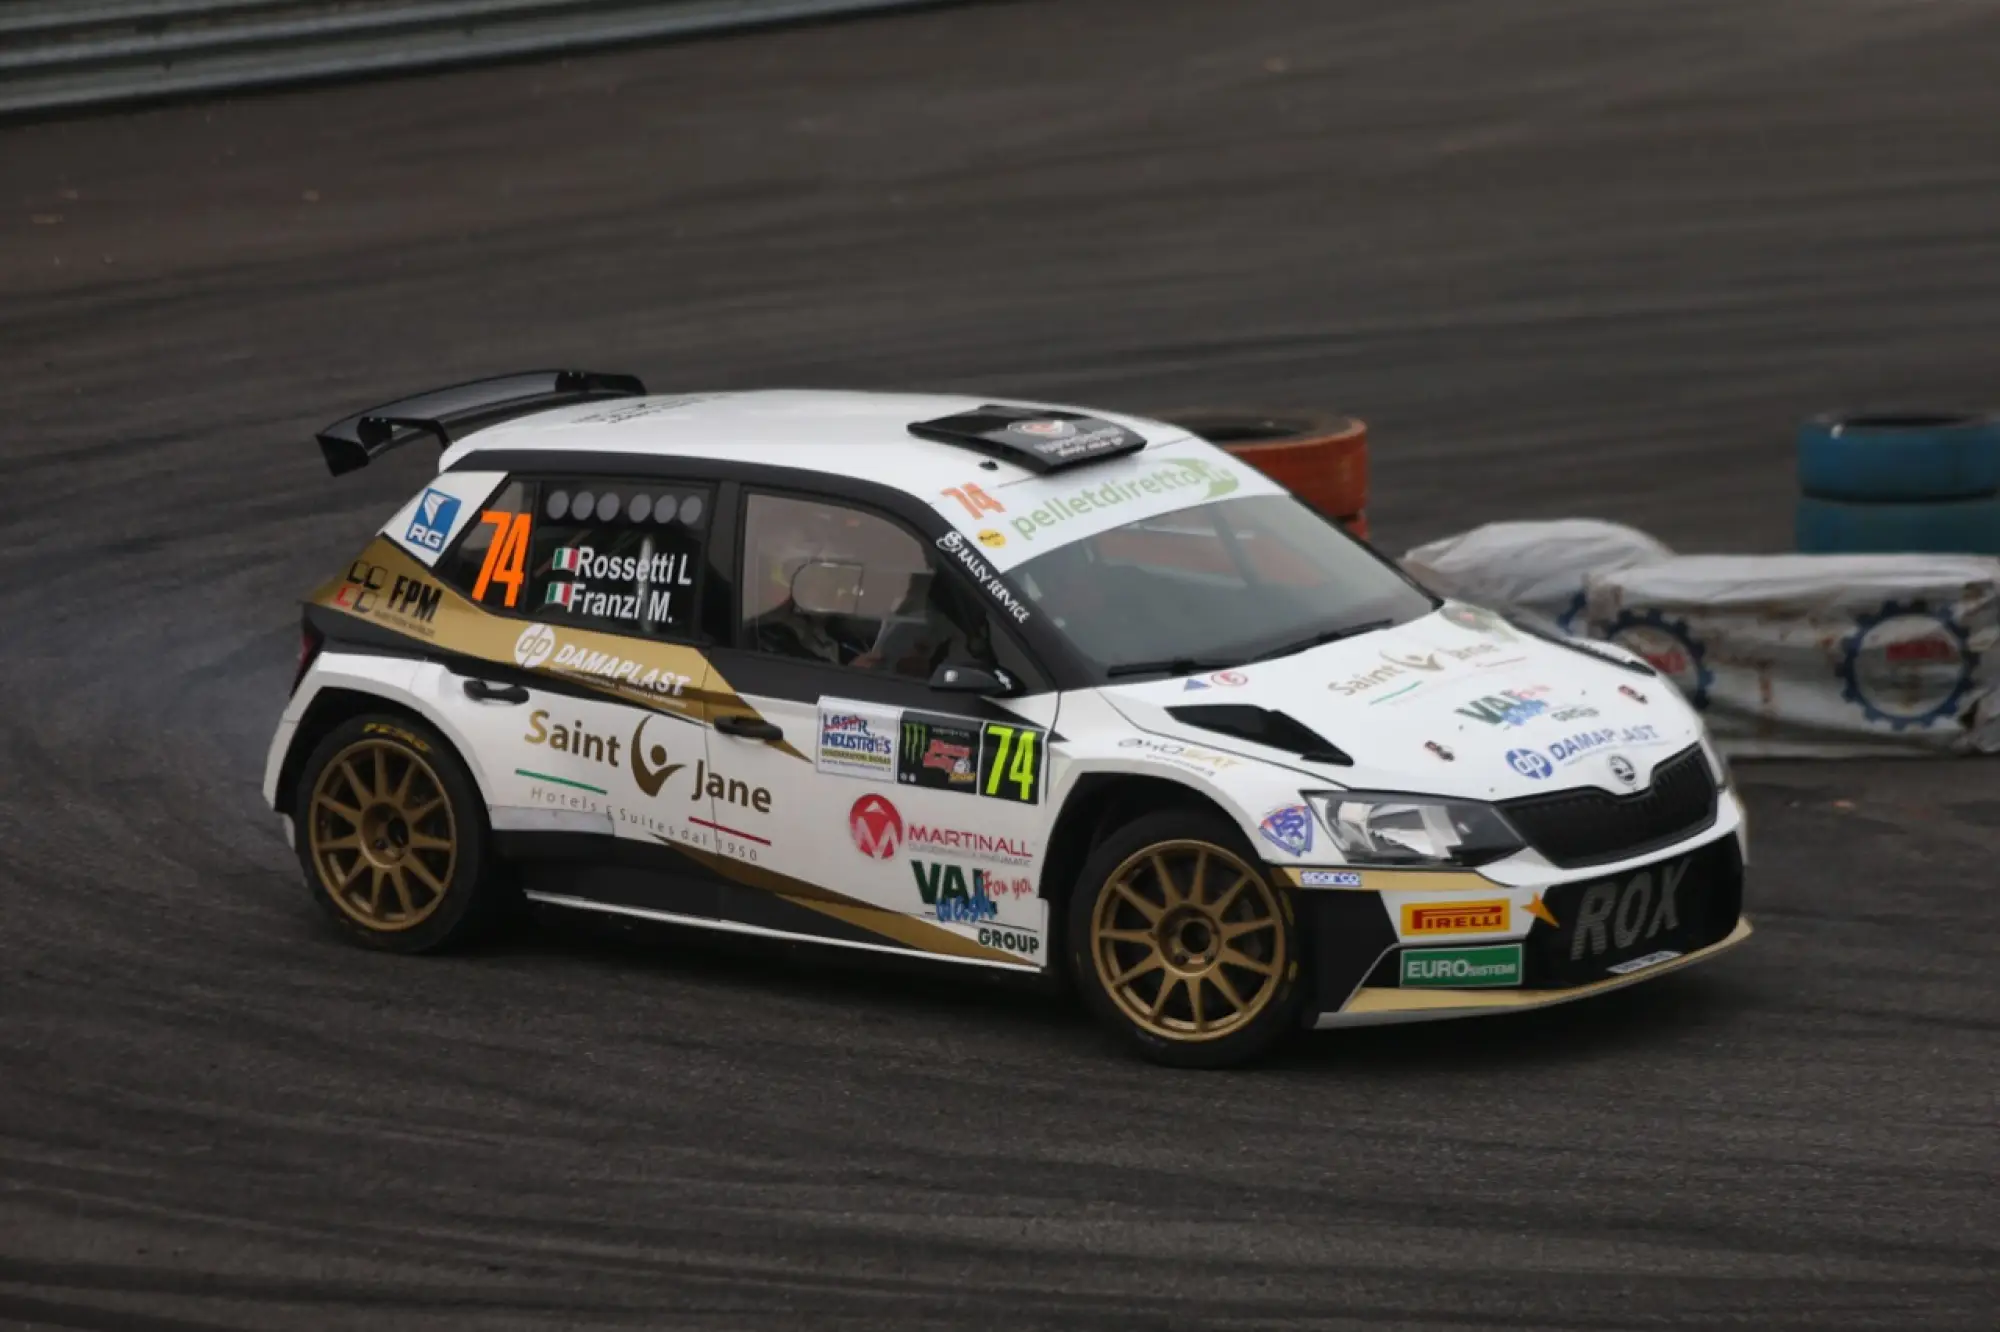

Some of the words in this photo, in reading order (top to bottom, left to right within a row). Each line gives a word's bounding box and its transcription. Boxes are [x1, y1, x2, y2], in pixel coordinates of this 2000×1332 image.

[940, 482, 1006, 520] 74
[410, 523, 446, 550] RG
[472, 510, 532, 608] 74
[574, 546, 675, 584] Rossetti
[677, 553, 693, 585] L
[386, 573, 444, 623] FPM
[566, 582, 643, 620] Franzi
[646, 590, 673, 624] M.
[957, 546, 992, 584] RALLY
[986, 579, 1030, 624] SERVICE
[553, 643, 691, 696] DAMAPLAST
[1328, 664, 1406, 696] Saint
[524, 709, 621, 767] Saint
[691, 759, 772, 813] Jane
[986, 724, 1036, 801] 74
[1548, 724, 1660, 761] DAMAPAST
[530, 786, 597, 813] Hotels
[619, 807, 675, 838] Suites
[681, 829, 707, 848] dal
[716, 839, 758, 863] 1950
[908, 823, 1033, 858] MARTINALL
[1411, 905, 1504, 930] PIRELLI
[1570, 857, 1692, 961] ROX
[978, 927, 1040, 955] GROUP
